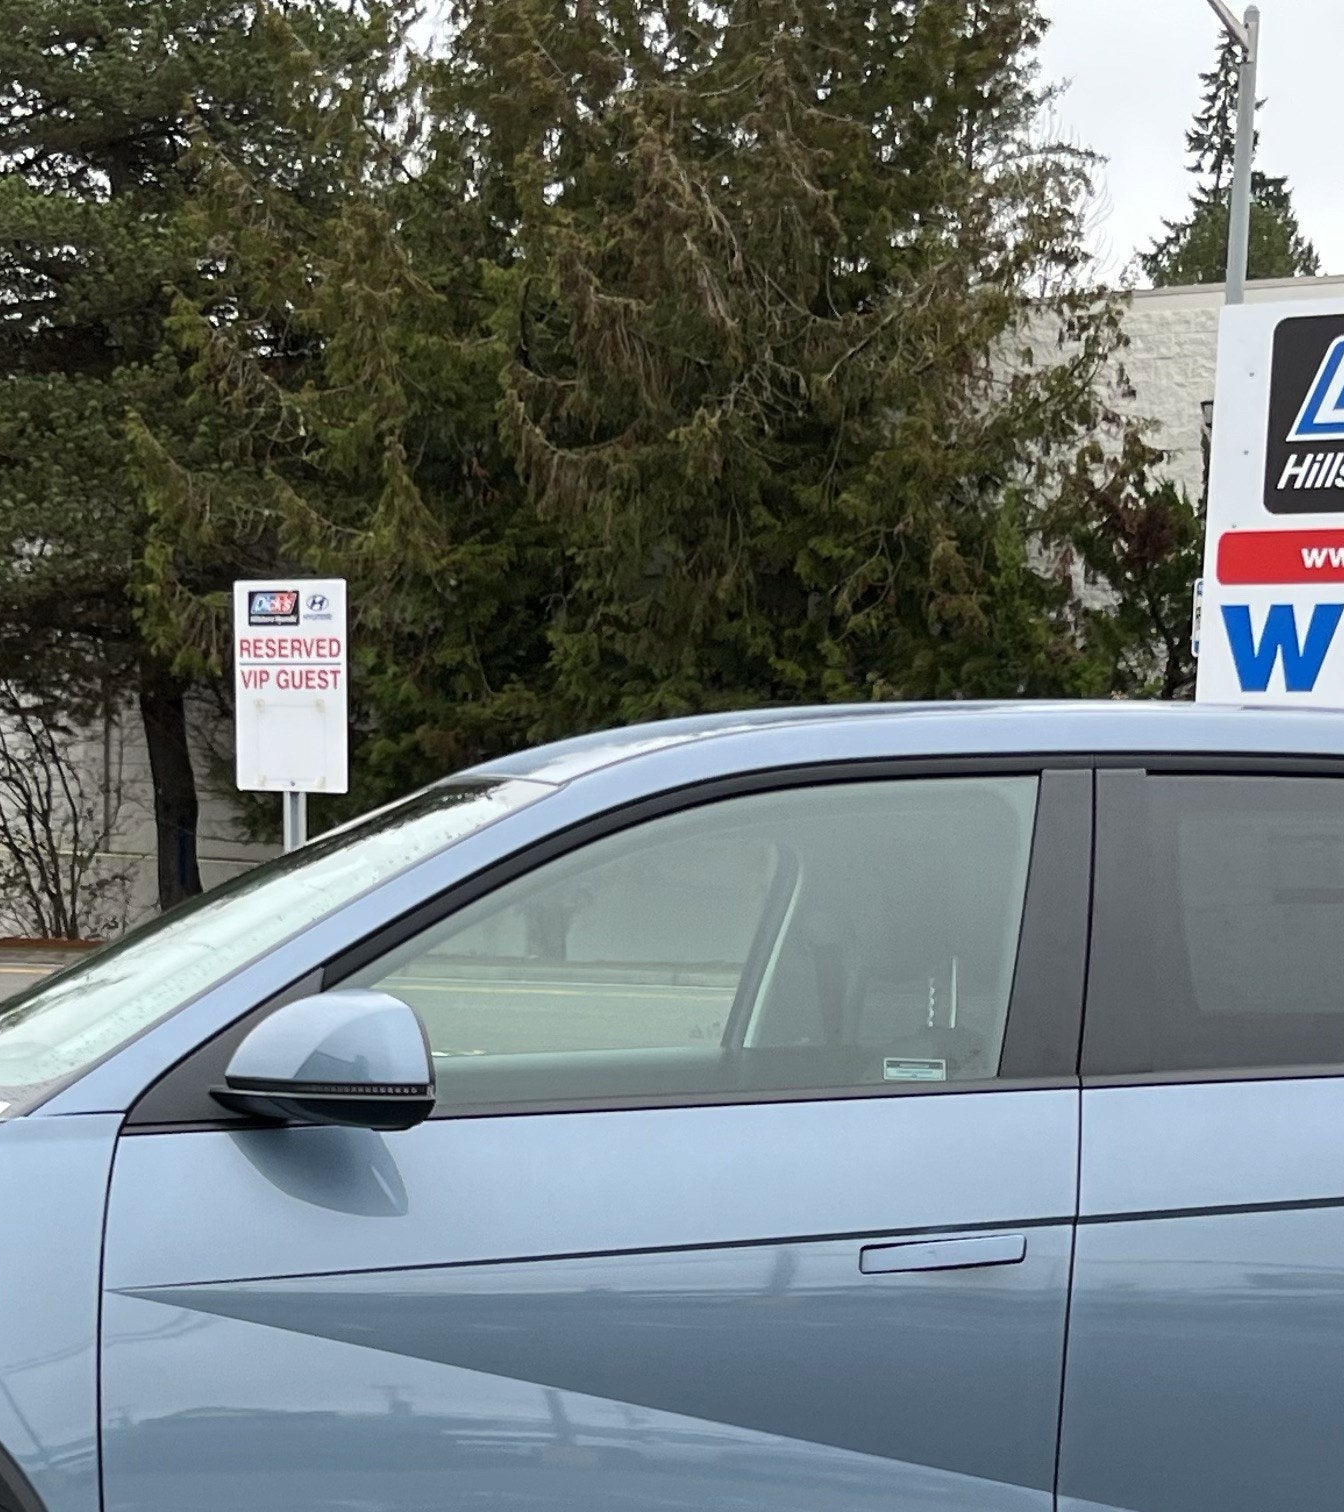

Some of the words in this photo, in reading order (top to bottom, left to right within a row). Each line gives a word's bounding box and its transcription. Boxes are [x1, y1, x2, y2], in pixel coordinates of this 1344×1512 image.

[239, 638, 341, 658] RESERVED
[240, 669, 270, 690] VIP
[276, 669, 341, 690] GUEST
